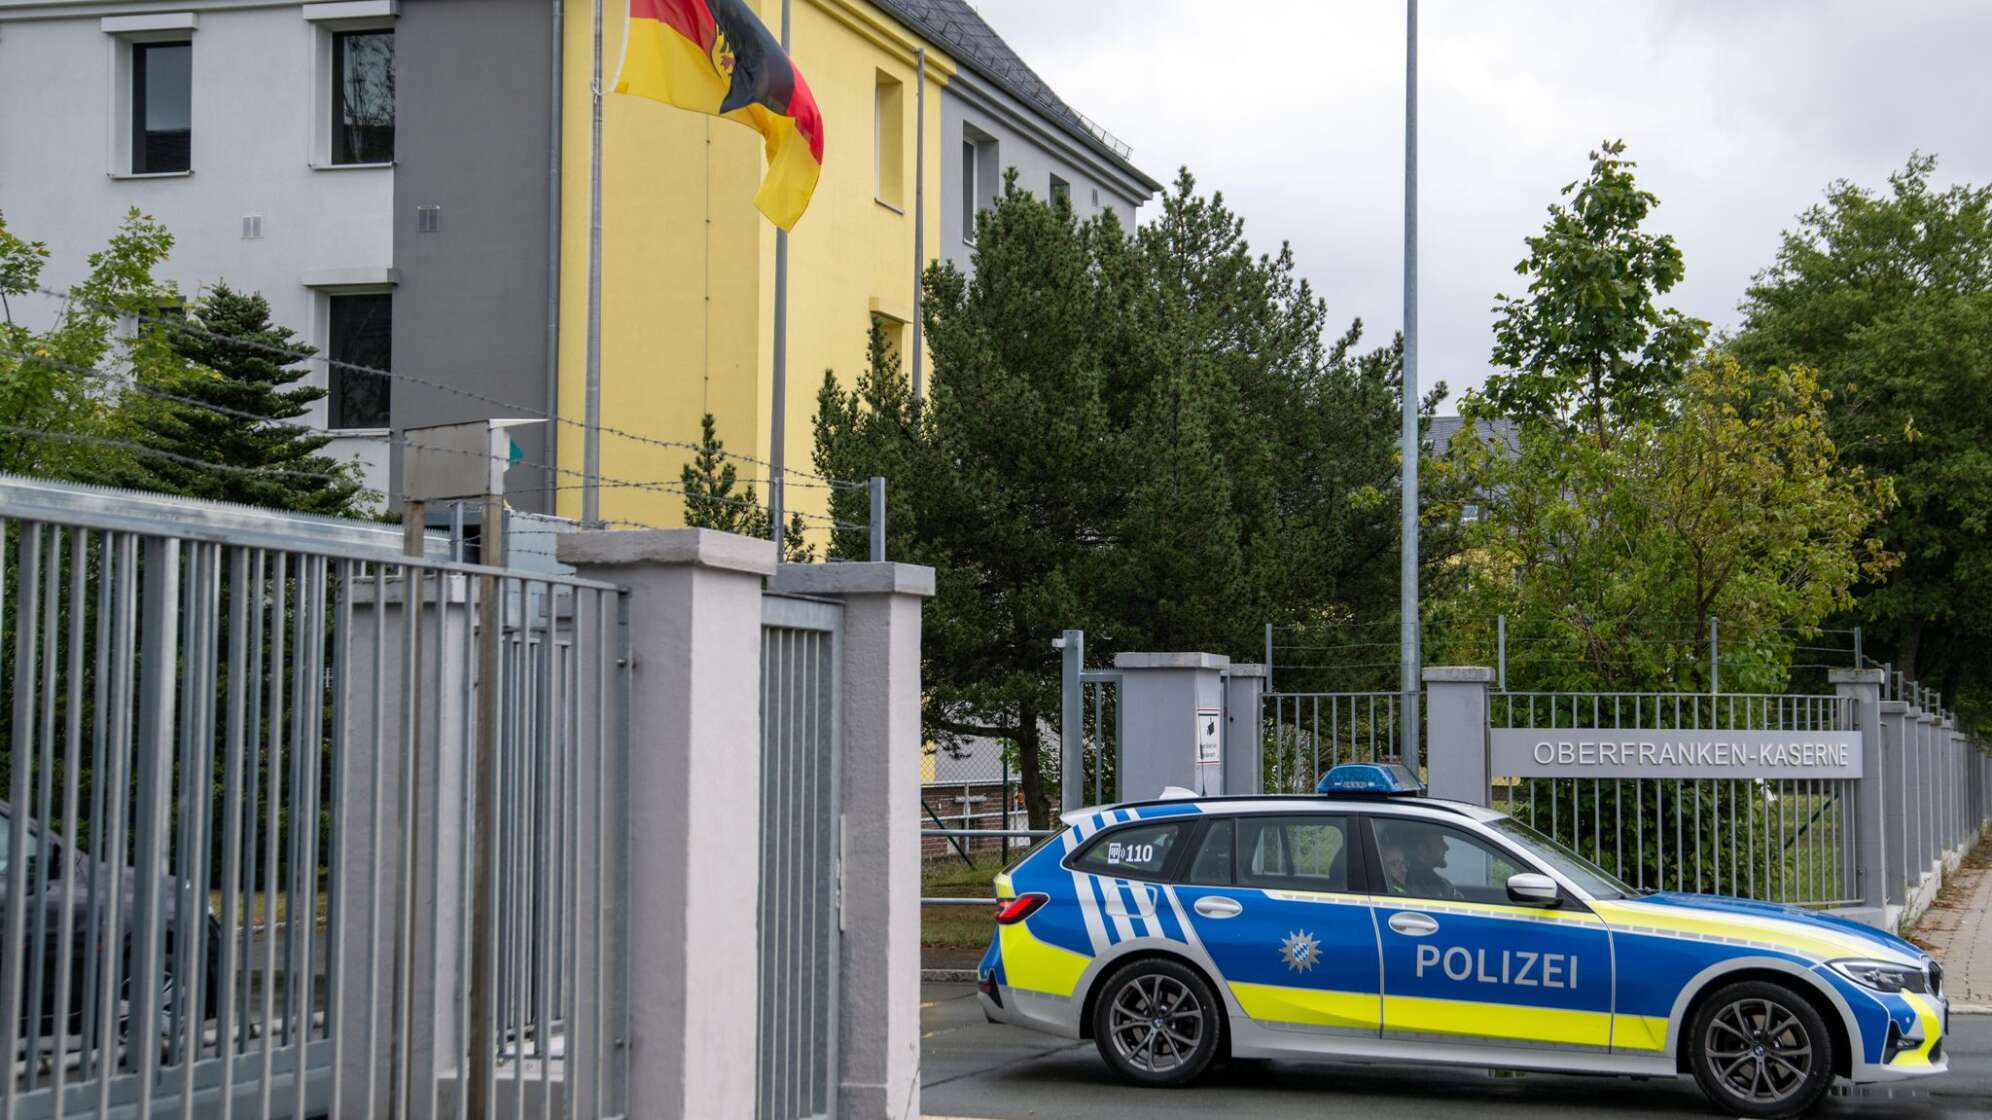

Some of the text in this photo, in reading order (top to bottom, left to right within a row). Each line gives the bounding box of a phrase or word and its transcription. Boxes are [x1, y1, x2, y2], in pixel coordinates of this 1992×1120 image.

[1534, 742, 1848, 766] OBERFRANKEN-KASERNE
[1125, 844, 1153, 862] 110
[1416, 944, 1578, 989] POLIZEI
